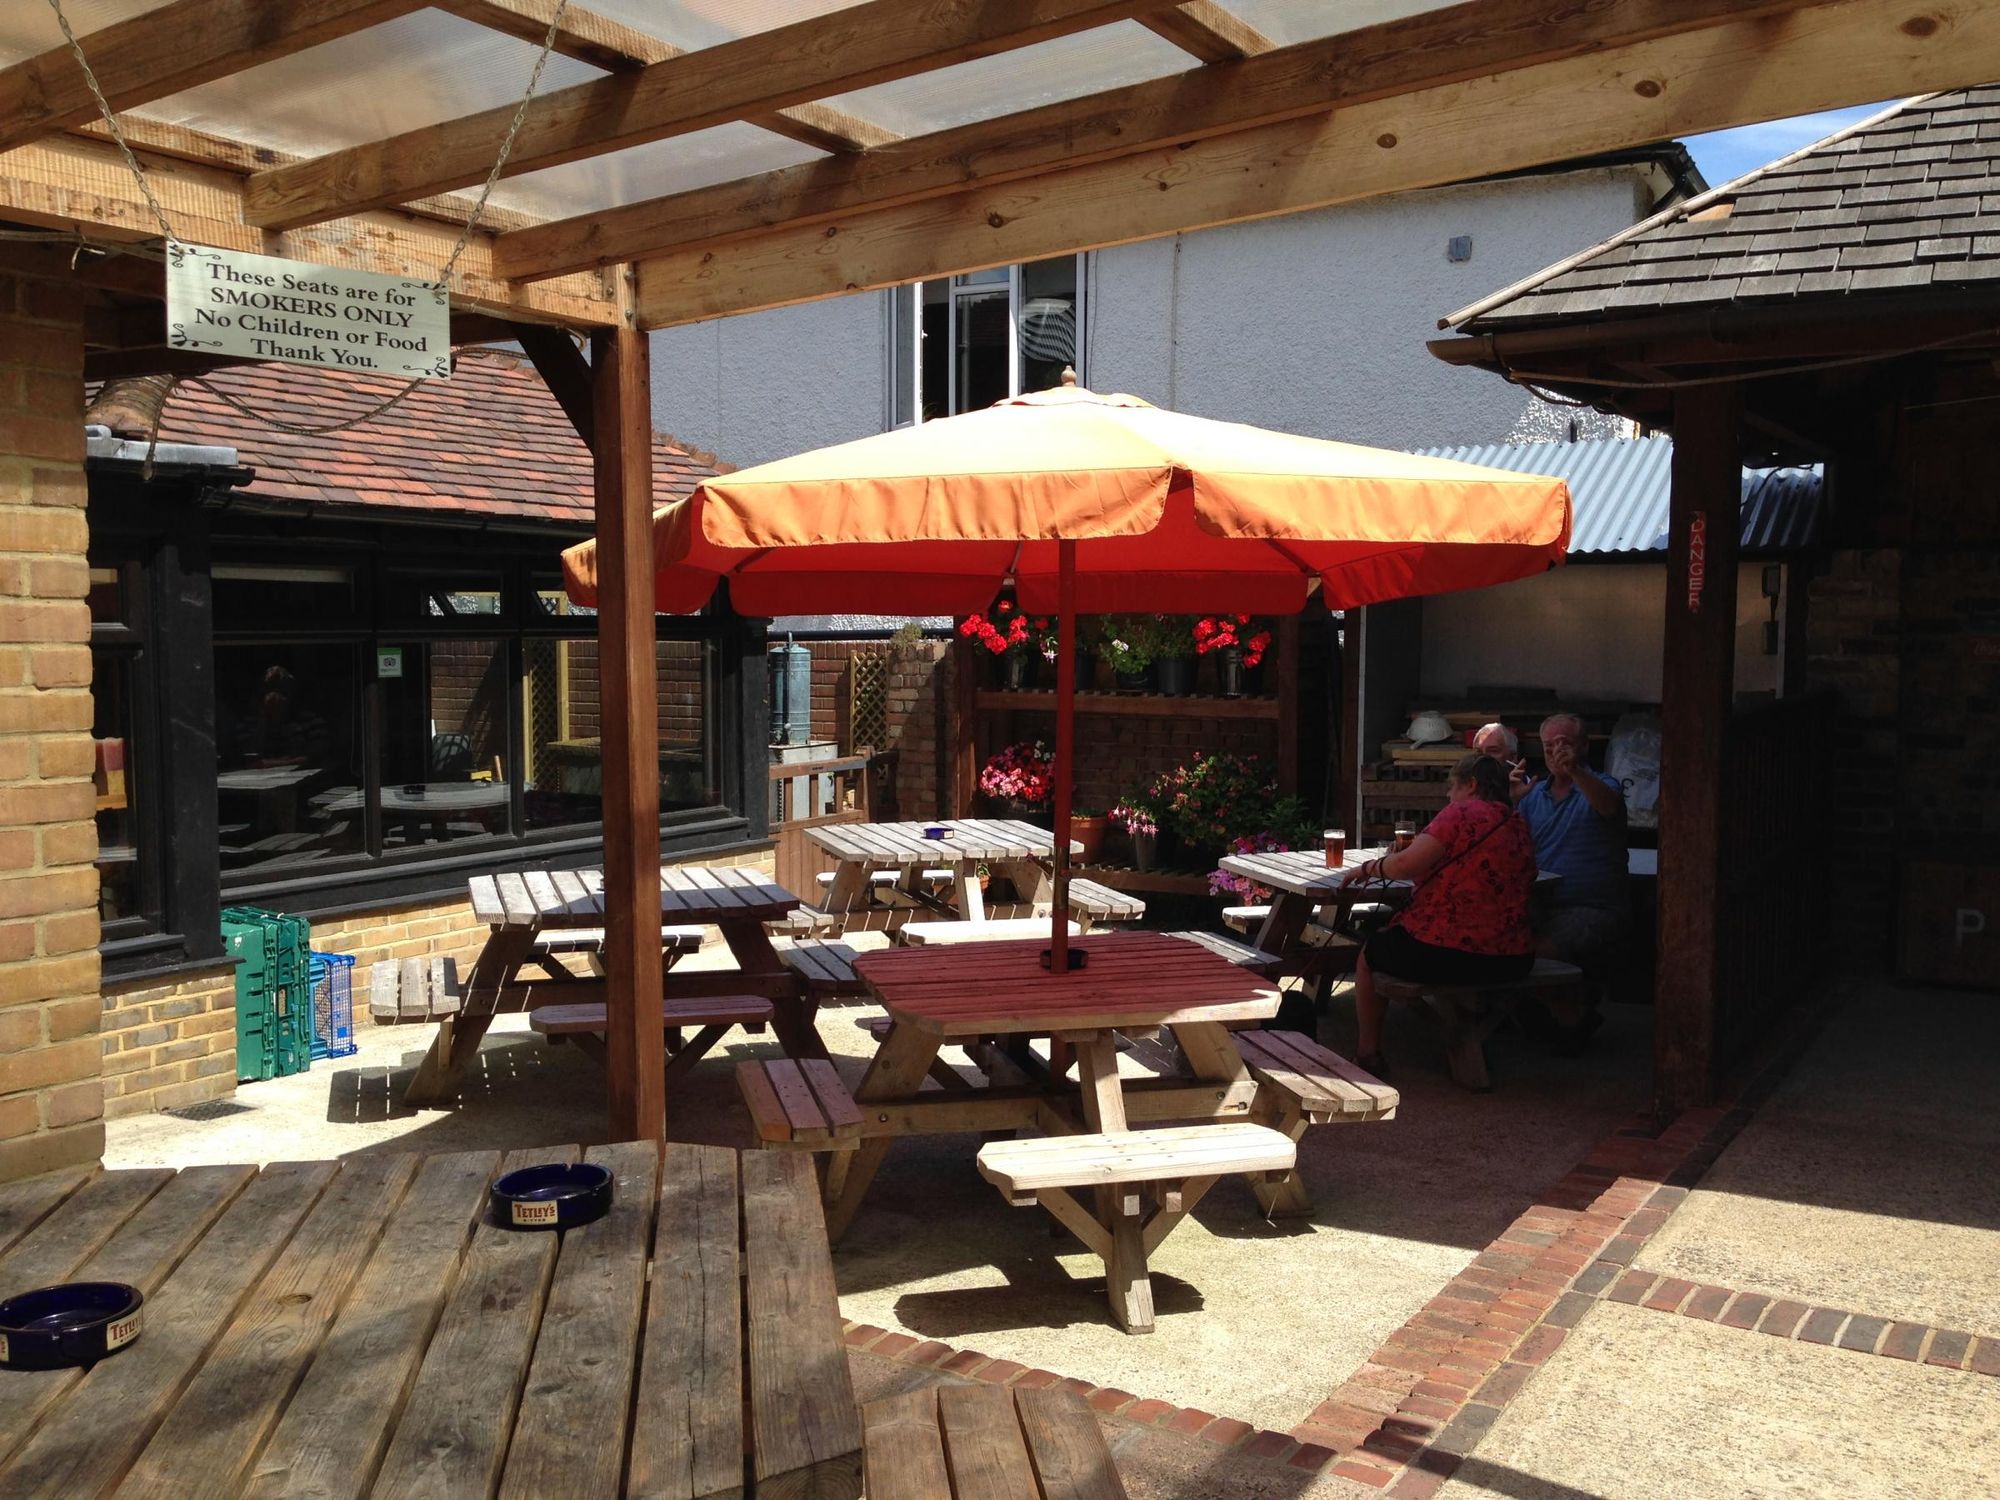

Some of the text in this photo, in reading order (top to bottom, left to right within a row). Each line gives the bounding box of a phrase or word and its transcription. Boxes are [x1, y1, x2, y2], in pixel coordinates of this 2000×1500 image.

[206, 262, 416, 307] These Seats are for
[211, 287, 414, 328] SMOKERS ONLY
[194, 308, 428, 352] No Children or Food
[250, 338, 378, 368] Thank You.
[1688, 519, 1704, 606] DANGER
[1956, 908, 1985, 947] P
[514, 1203, 556, 1218] TETLEY'S
